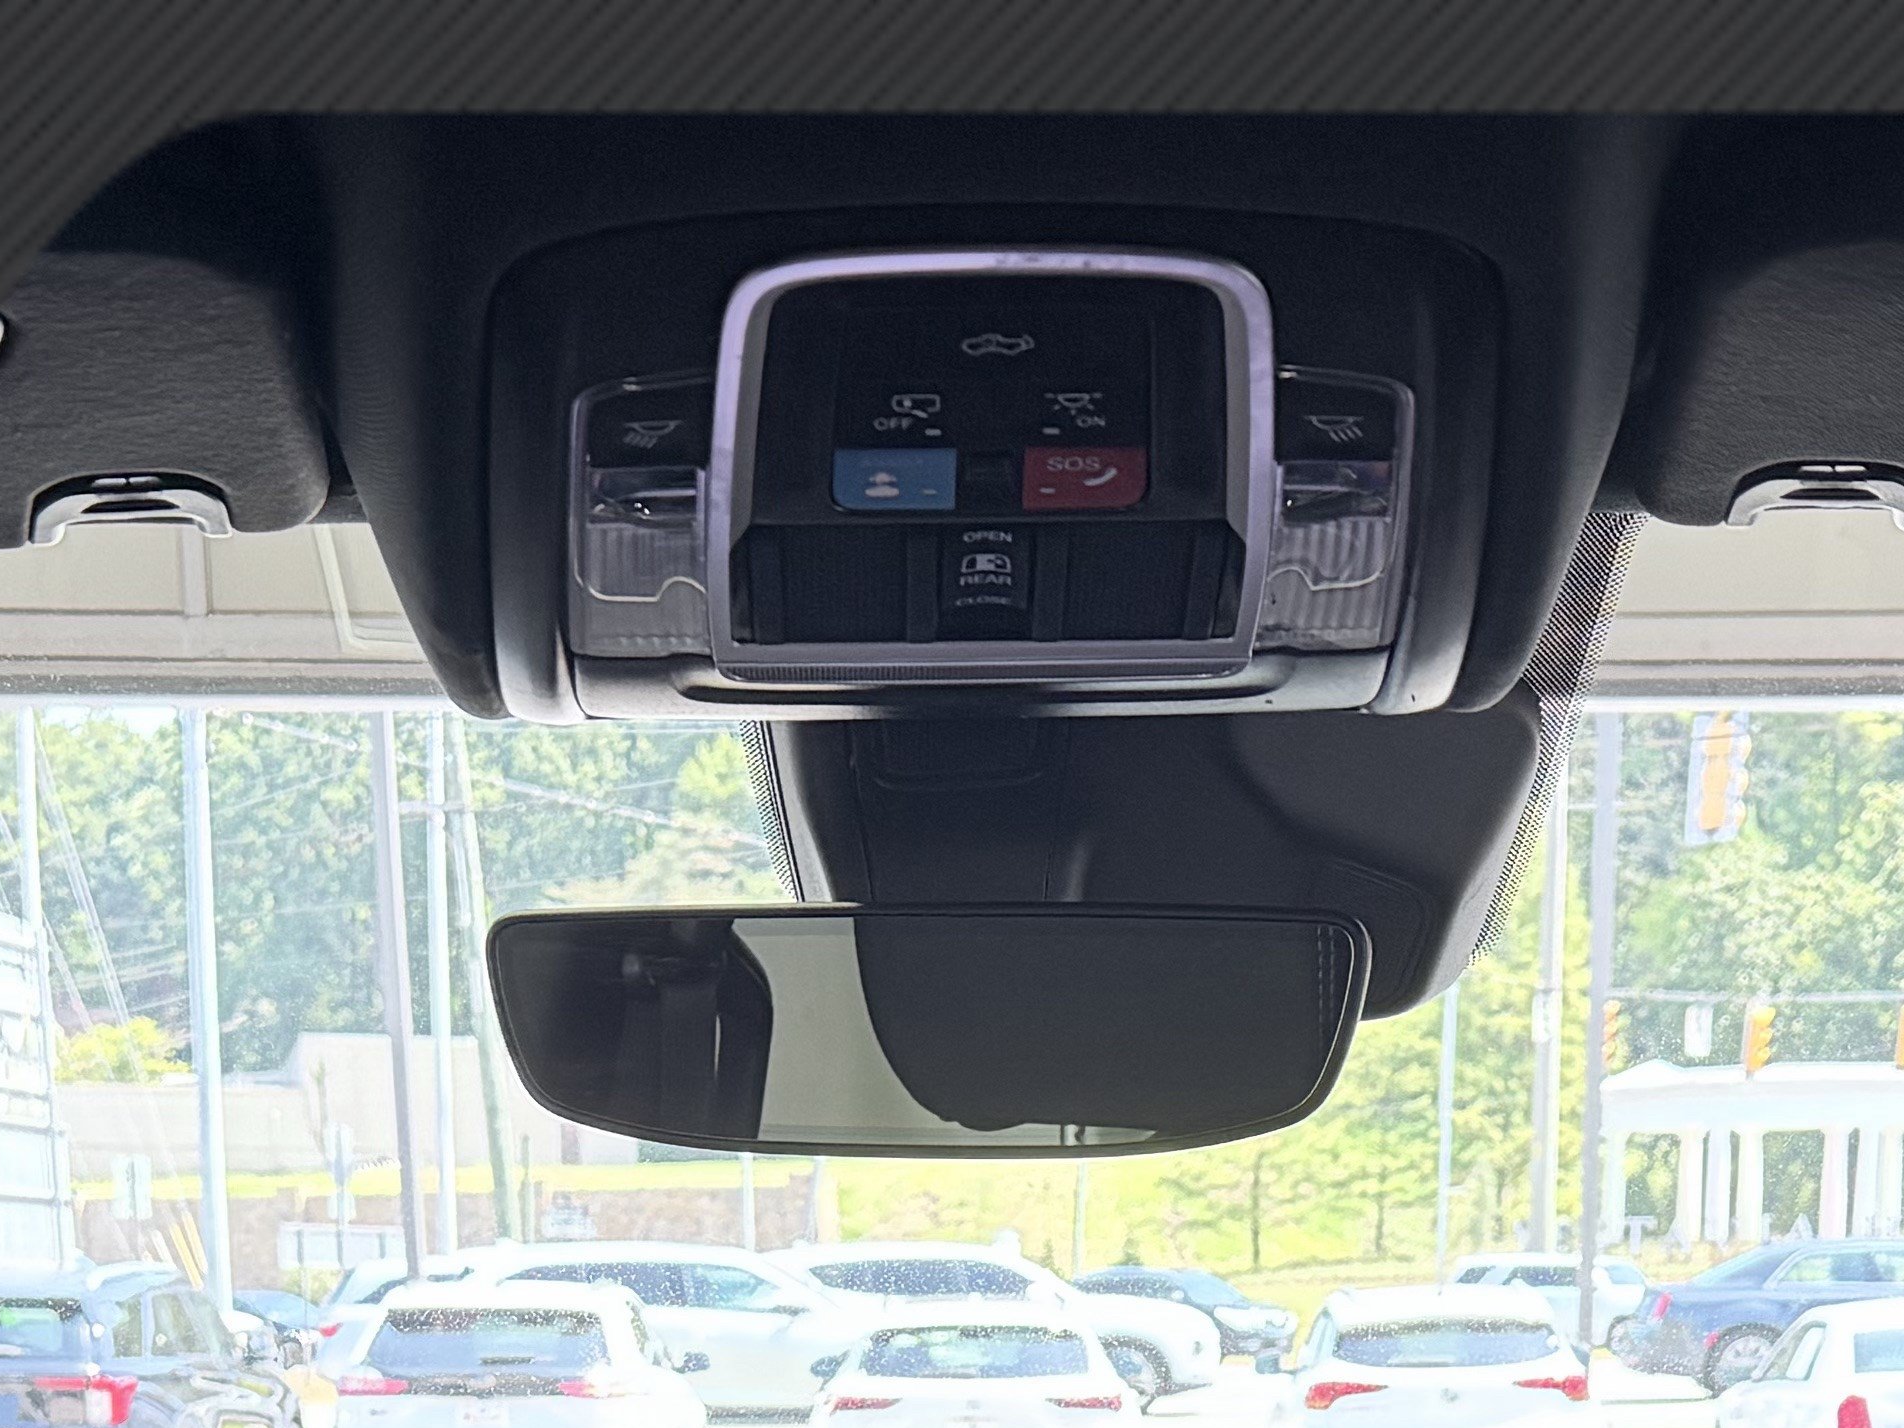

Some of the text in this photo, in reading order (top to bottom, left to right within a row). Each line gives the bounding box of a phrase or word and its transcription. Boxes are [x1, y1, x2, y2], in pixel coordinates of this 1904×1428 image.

[1046, 456, 1101, 471] SOS
[962, 531, 1013, 543] OPEN
[959, 573, 1012, 586] REAR
